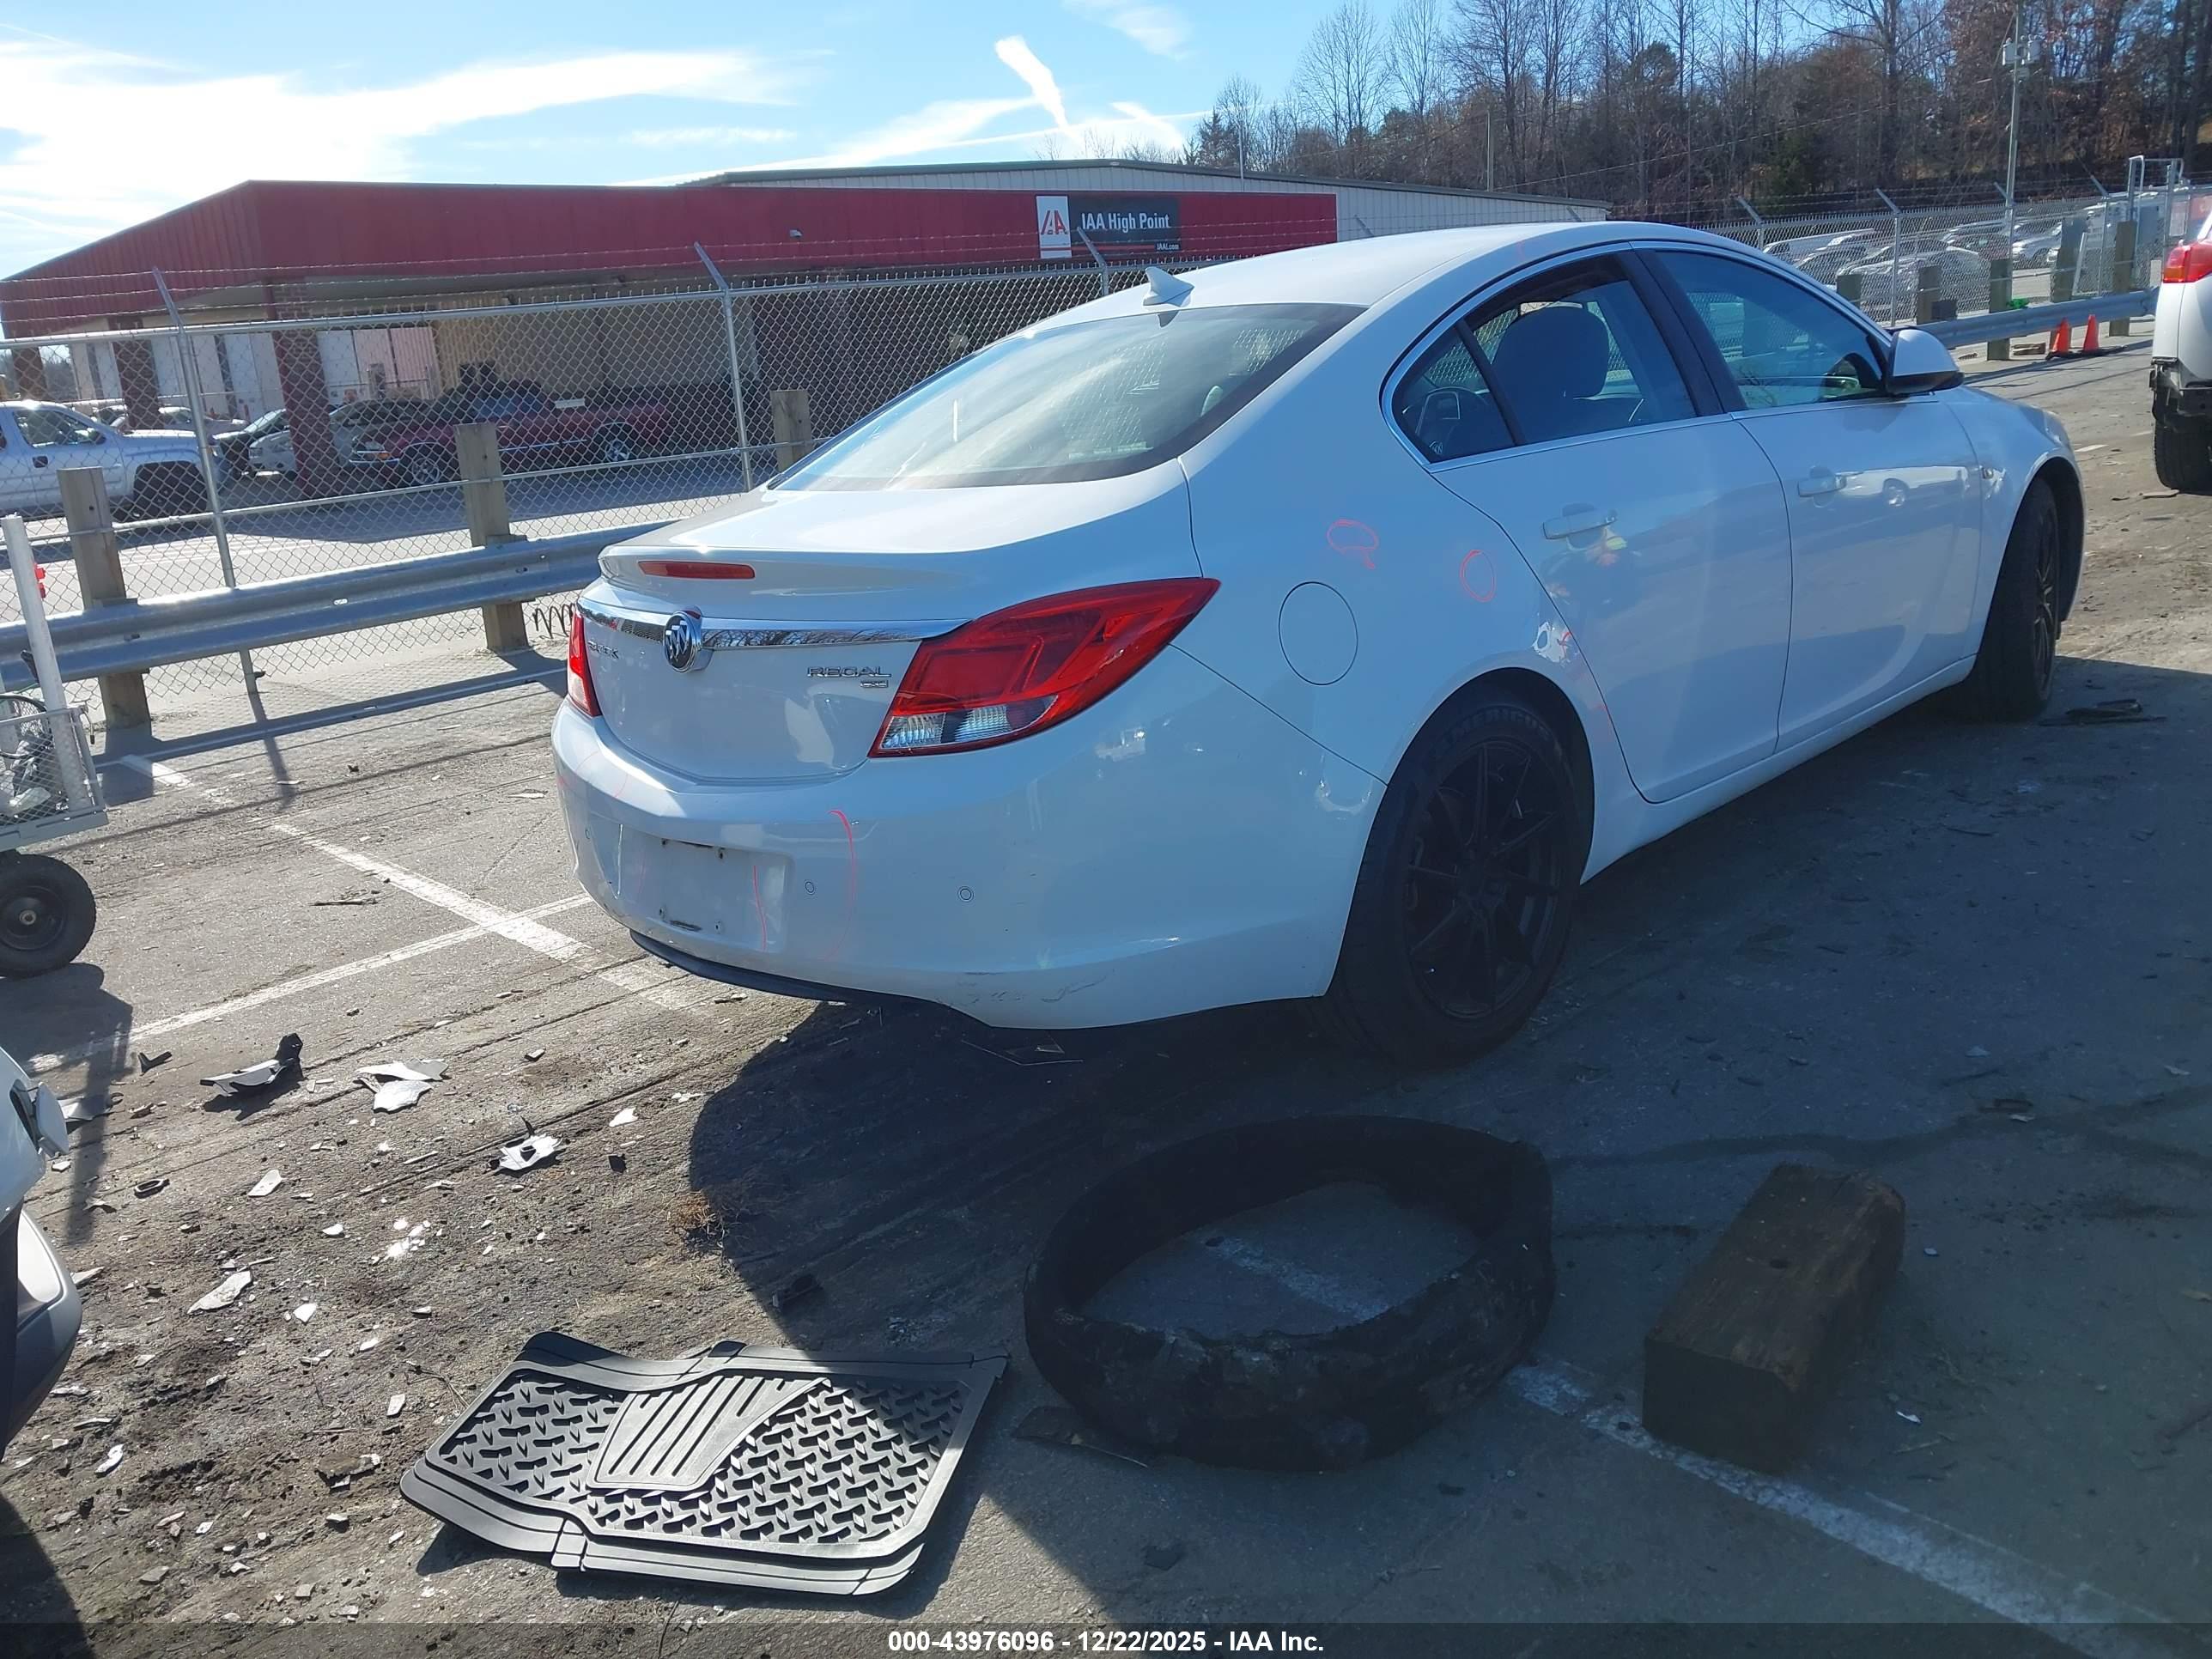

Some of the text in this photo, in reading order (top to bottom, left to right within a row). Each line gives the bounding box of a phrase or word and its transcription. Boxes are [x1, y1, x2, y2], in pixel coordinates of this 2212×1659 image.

[1082, 212, 1170, 234] IAA High Point
[807, 665, 892, 678] REGAL
